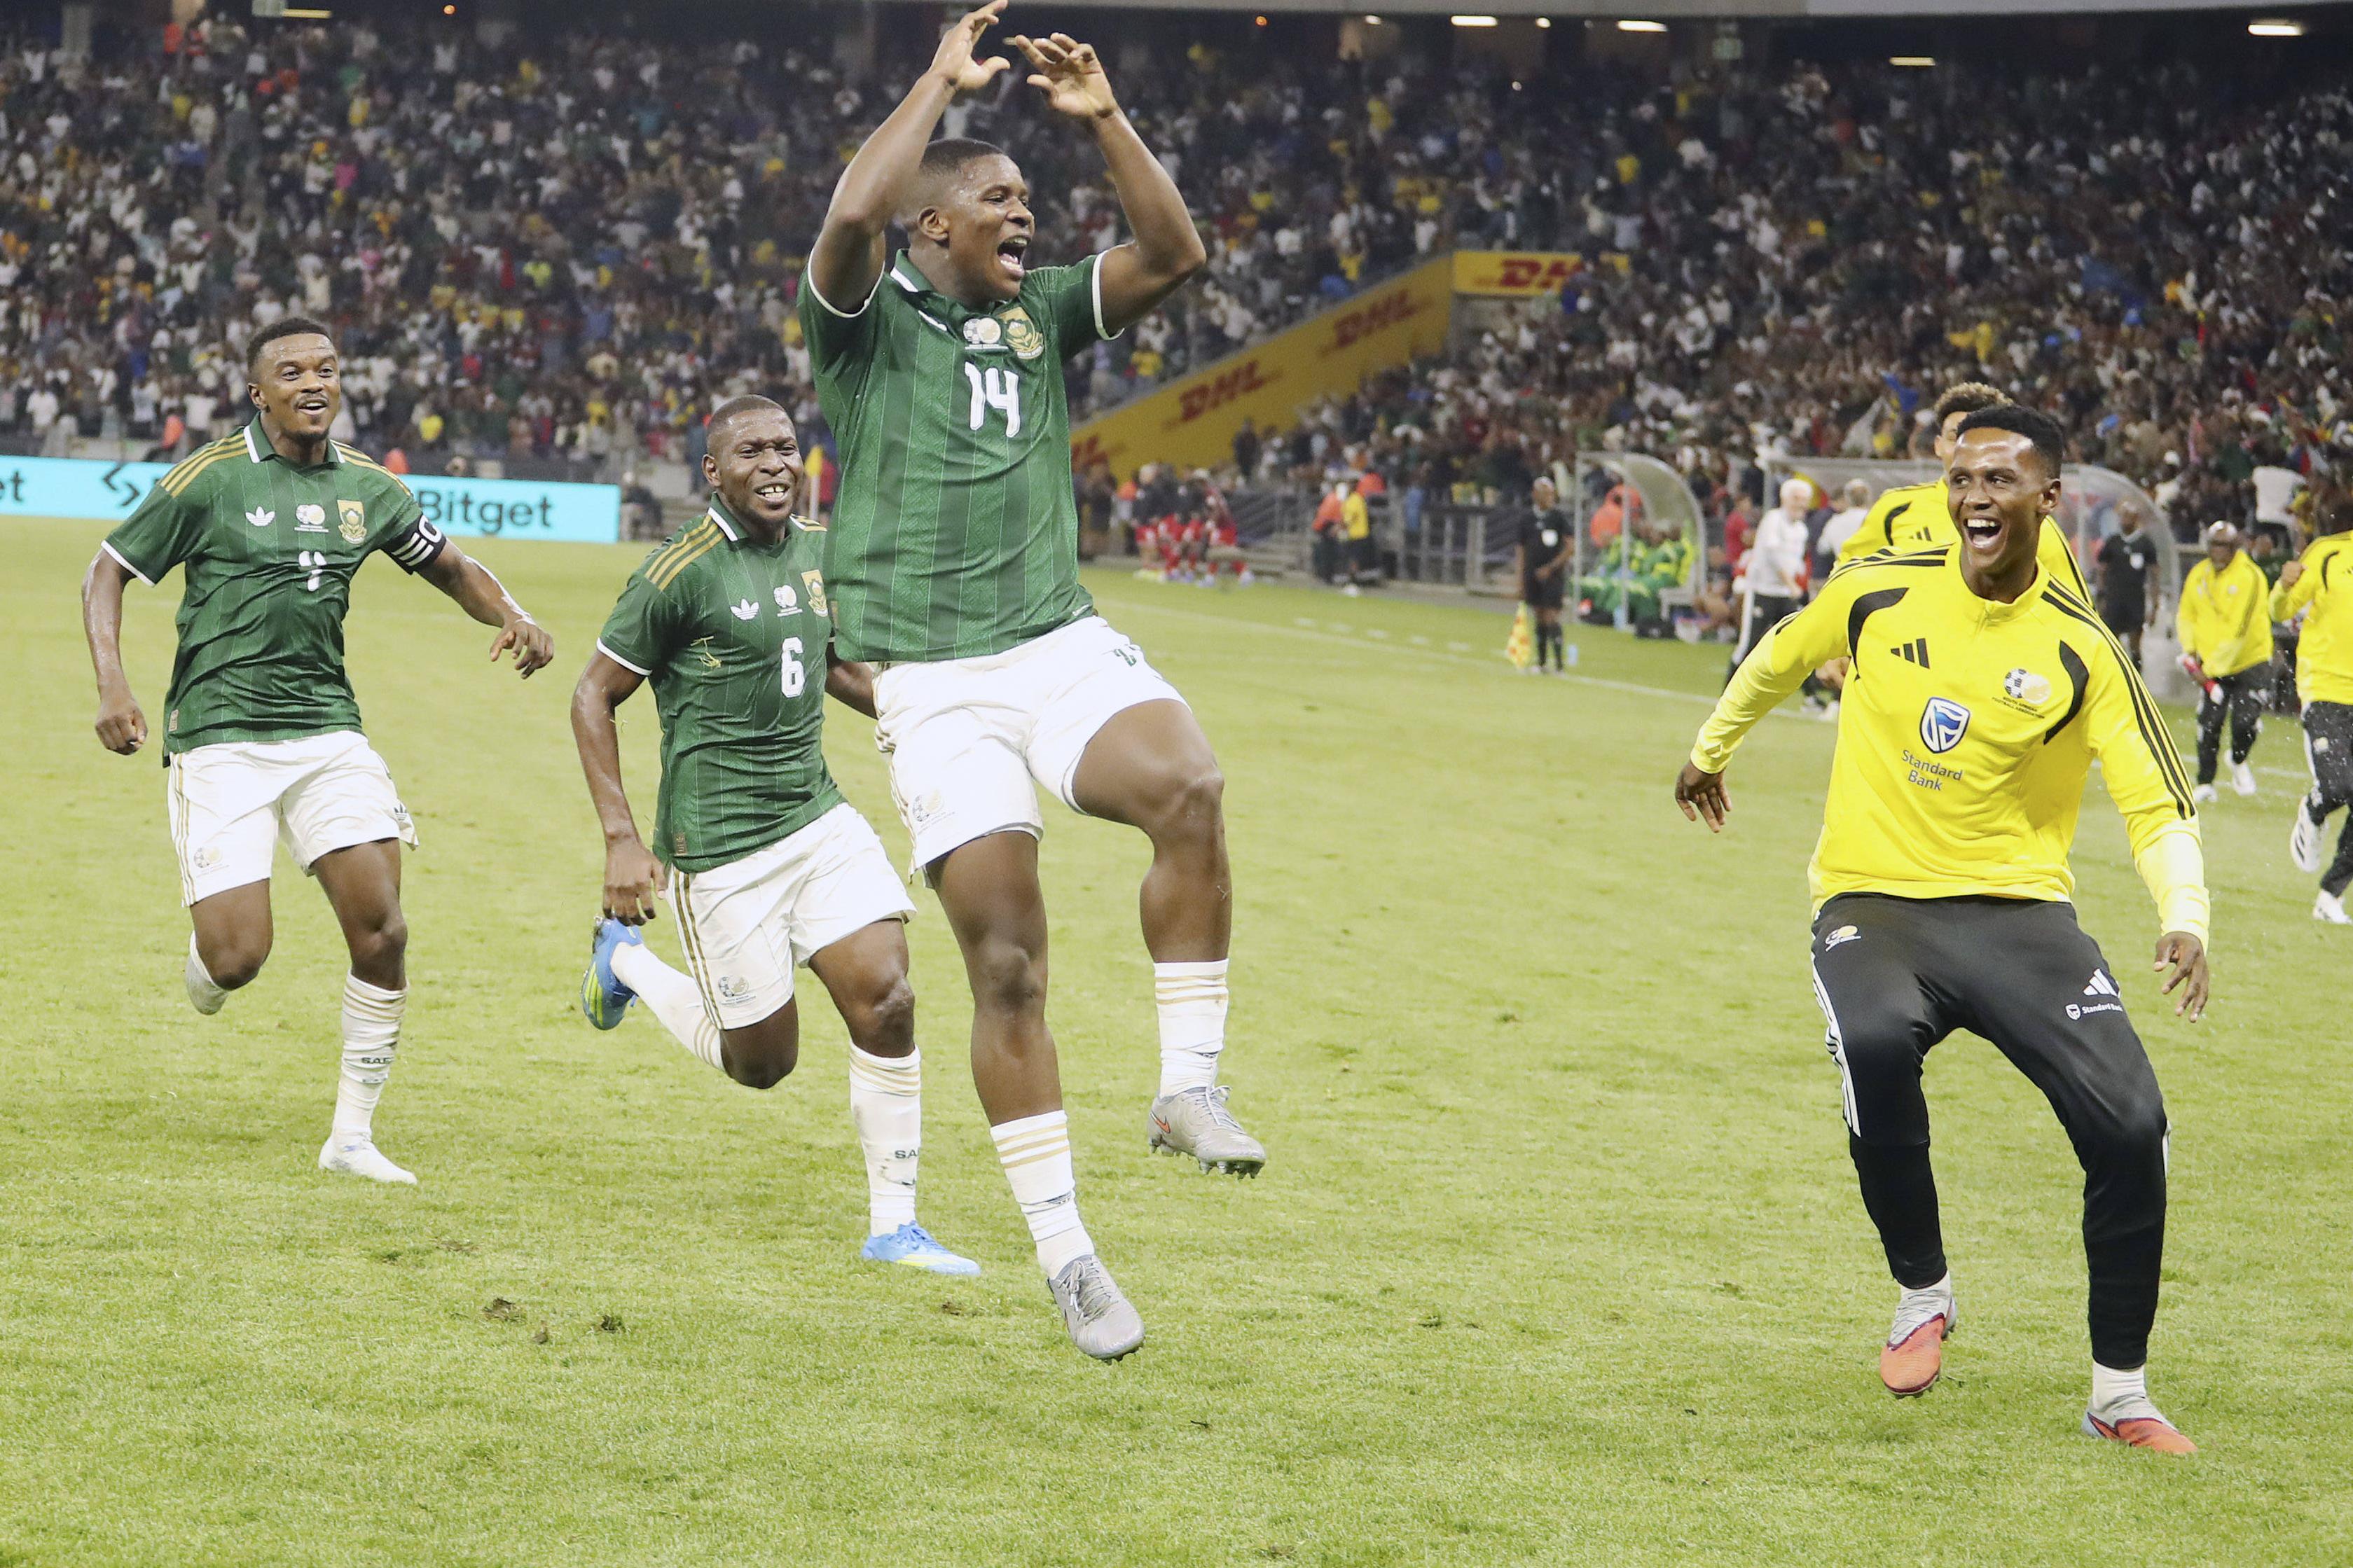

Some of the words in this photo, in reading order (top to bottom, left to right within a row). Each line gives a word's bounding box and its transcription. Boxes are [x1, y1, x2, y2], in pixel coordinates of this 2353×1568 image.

[1334, 289, 1417, 348] DHL
[964, 361, 1020, 438] 14
[1179, 360, 1266, 422] DHL
[419, 490, 551, 535] Bitget
[781, 637, 805, 698] 6
[1901, 749, 1963, 781] Standard
[1908, 769, 1943, 791] Bank
[2081, 1004, 2111, 1014] Standard
